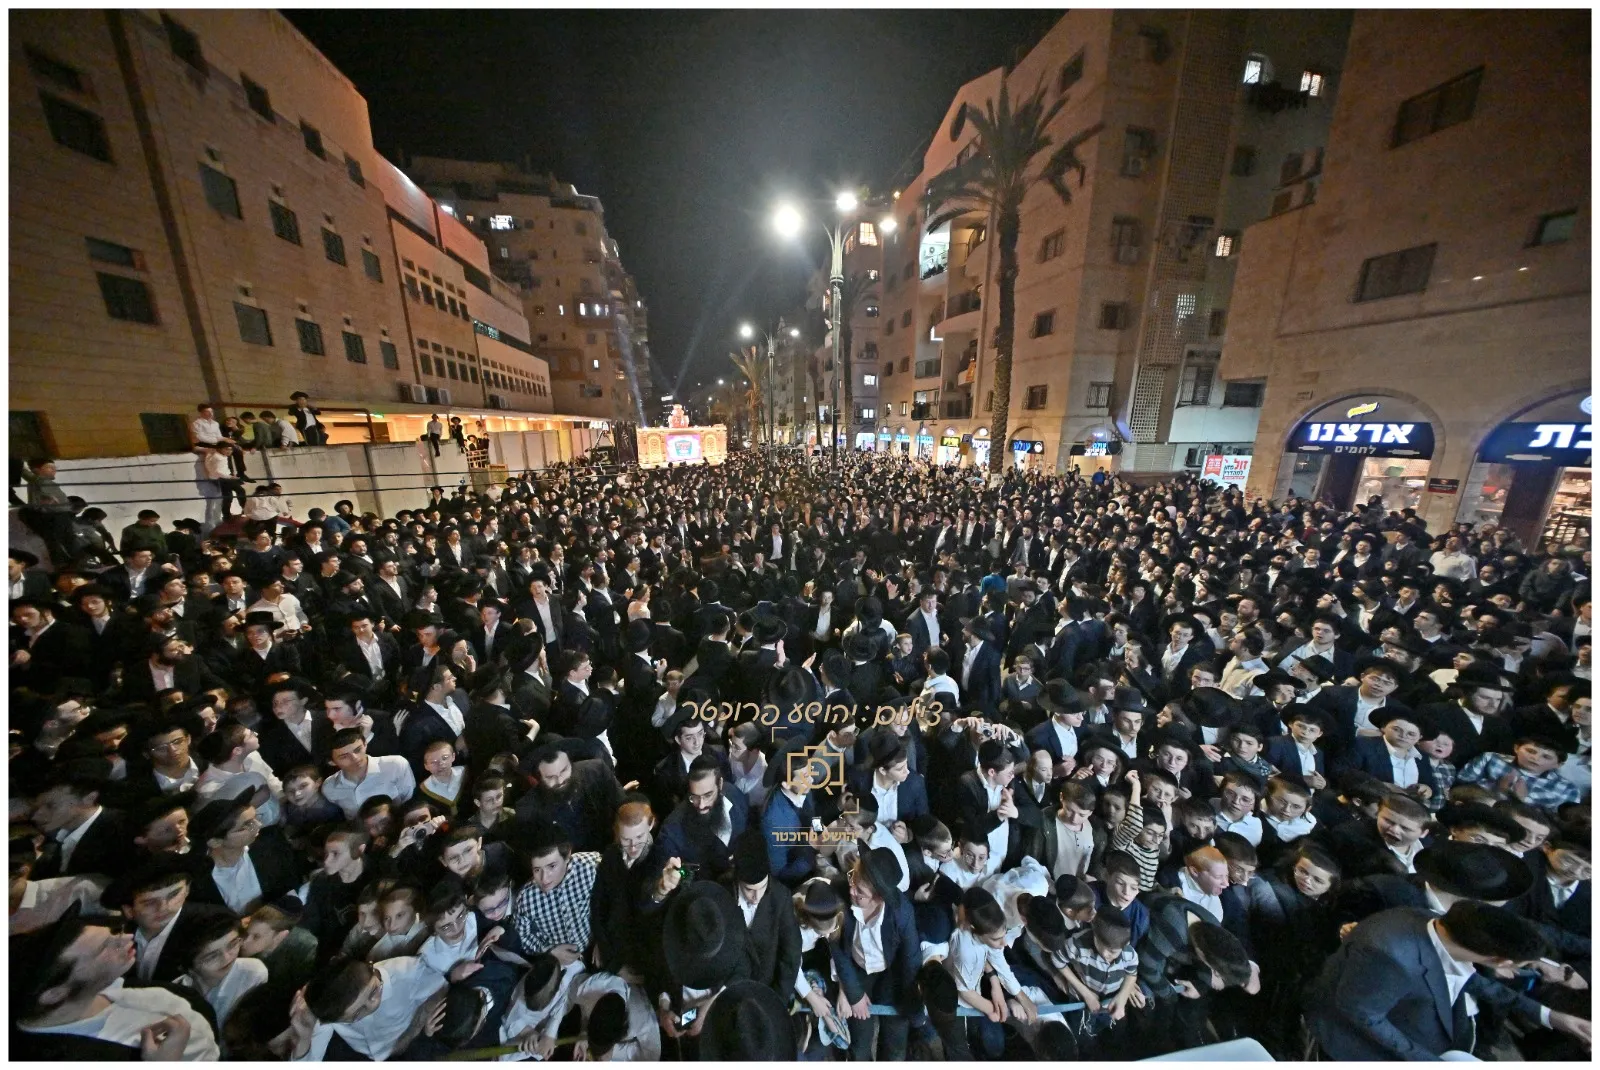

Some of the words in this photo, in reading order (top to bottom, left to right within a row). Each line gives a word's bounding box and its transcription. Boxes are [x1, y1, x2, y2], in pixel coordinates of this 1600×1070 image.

[1308, 423, 1415, 444] ארצנו
[1334, 445, 1377, 456] לחמים
[1233, 458, 1249, 470] זול
